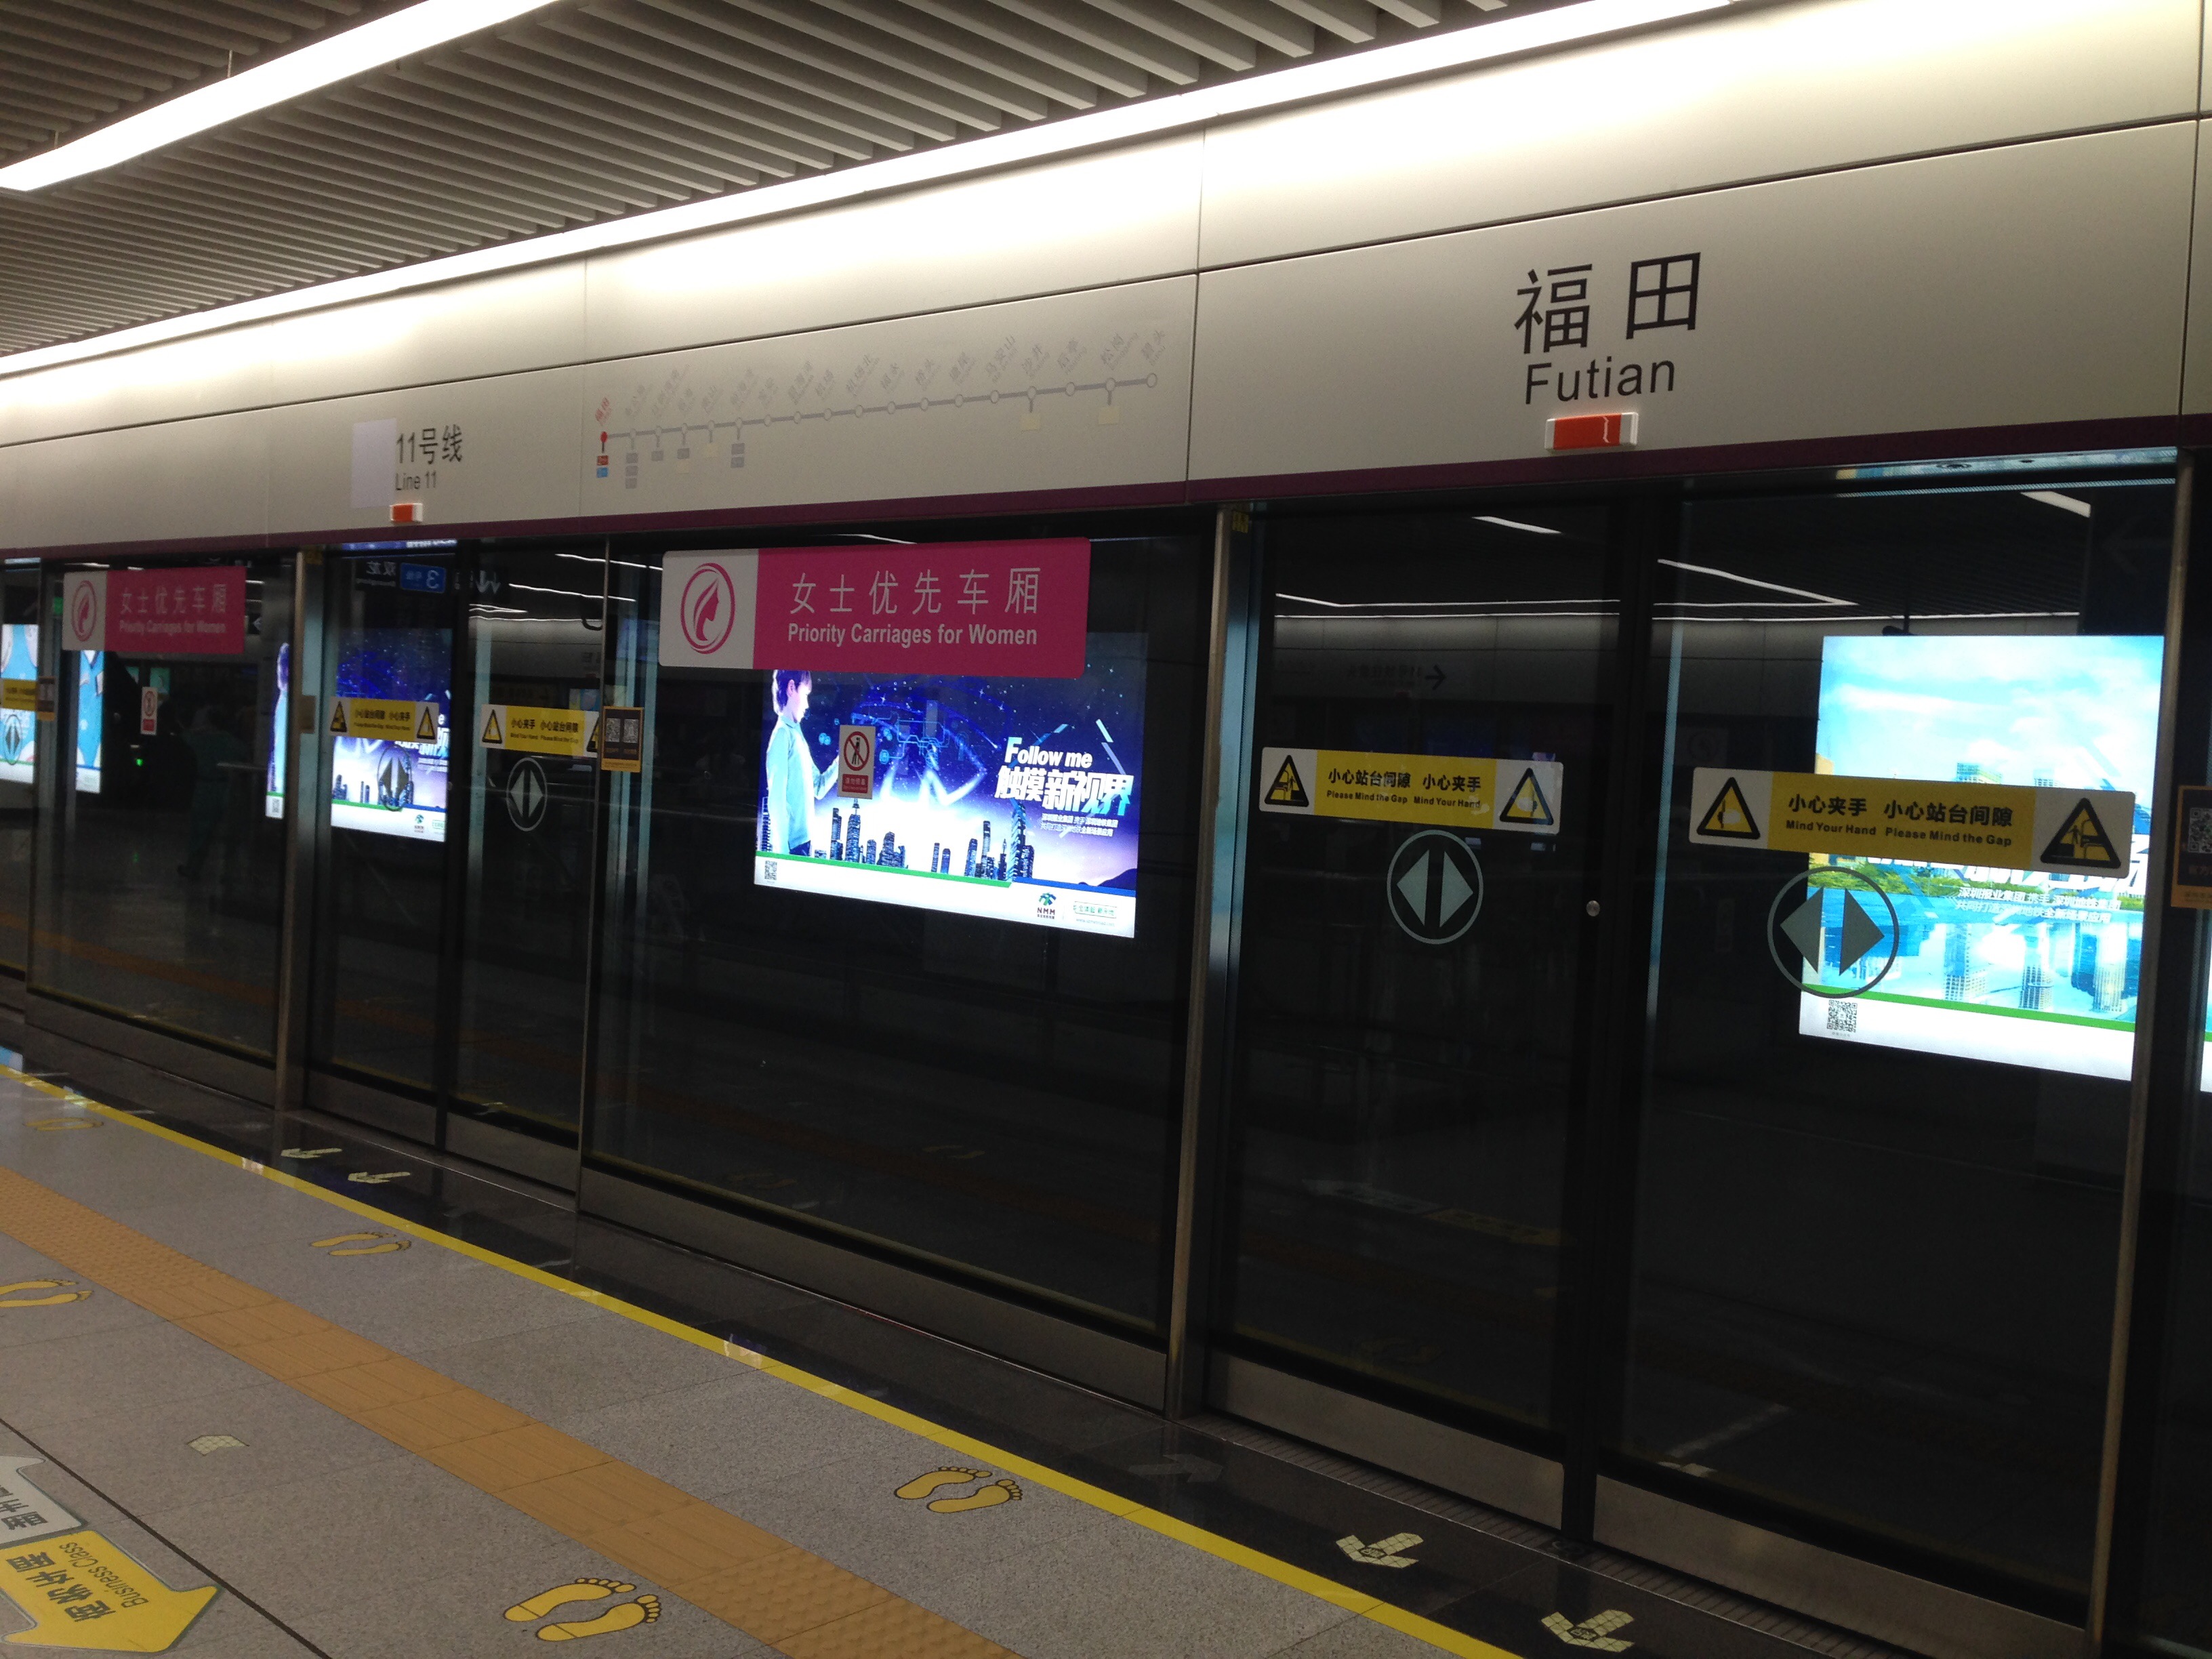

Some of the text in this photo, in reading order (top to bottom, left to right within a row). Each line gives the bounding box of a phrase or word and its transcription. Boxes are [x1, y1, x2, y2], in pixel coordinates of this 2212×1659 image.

[1513, 251, 1702, 354] 福田
[1525, 356, 1675, 405] Futian
[396, 424, 463, 465] 11号线
[395, 470, 436, 491] Line 11
[790, 567, 1041, 615] 女士优先车厢
[787, 623, 1038, 649] Priority Carriages for Women
[1004, 736, 1092, 769] Follow me
[994, 765, 1134, 816] 触摸新视界
[1328, 768, 1481, 793] 小心站台间隙 小心夹手
[1326, 790, 1481, 808] Please Mind the Gap Mind Your Hand
[1788, 794, 2013, 827] 小心夹手 小心站台间隙
[1786, 820, 2012, 847] Mind Your Hand Please Mind the Gap
[1037, 907, 1056, 916] NMM
[59, 1542, 149, 1608] Business Class
